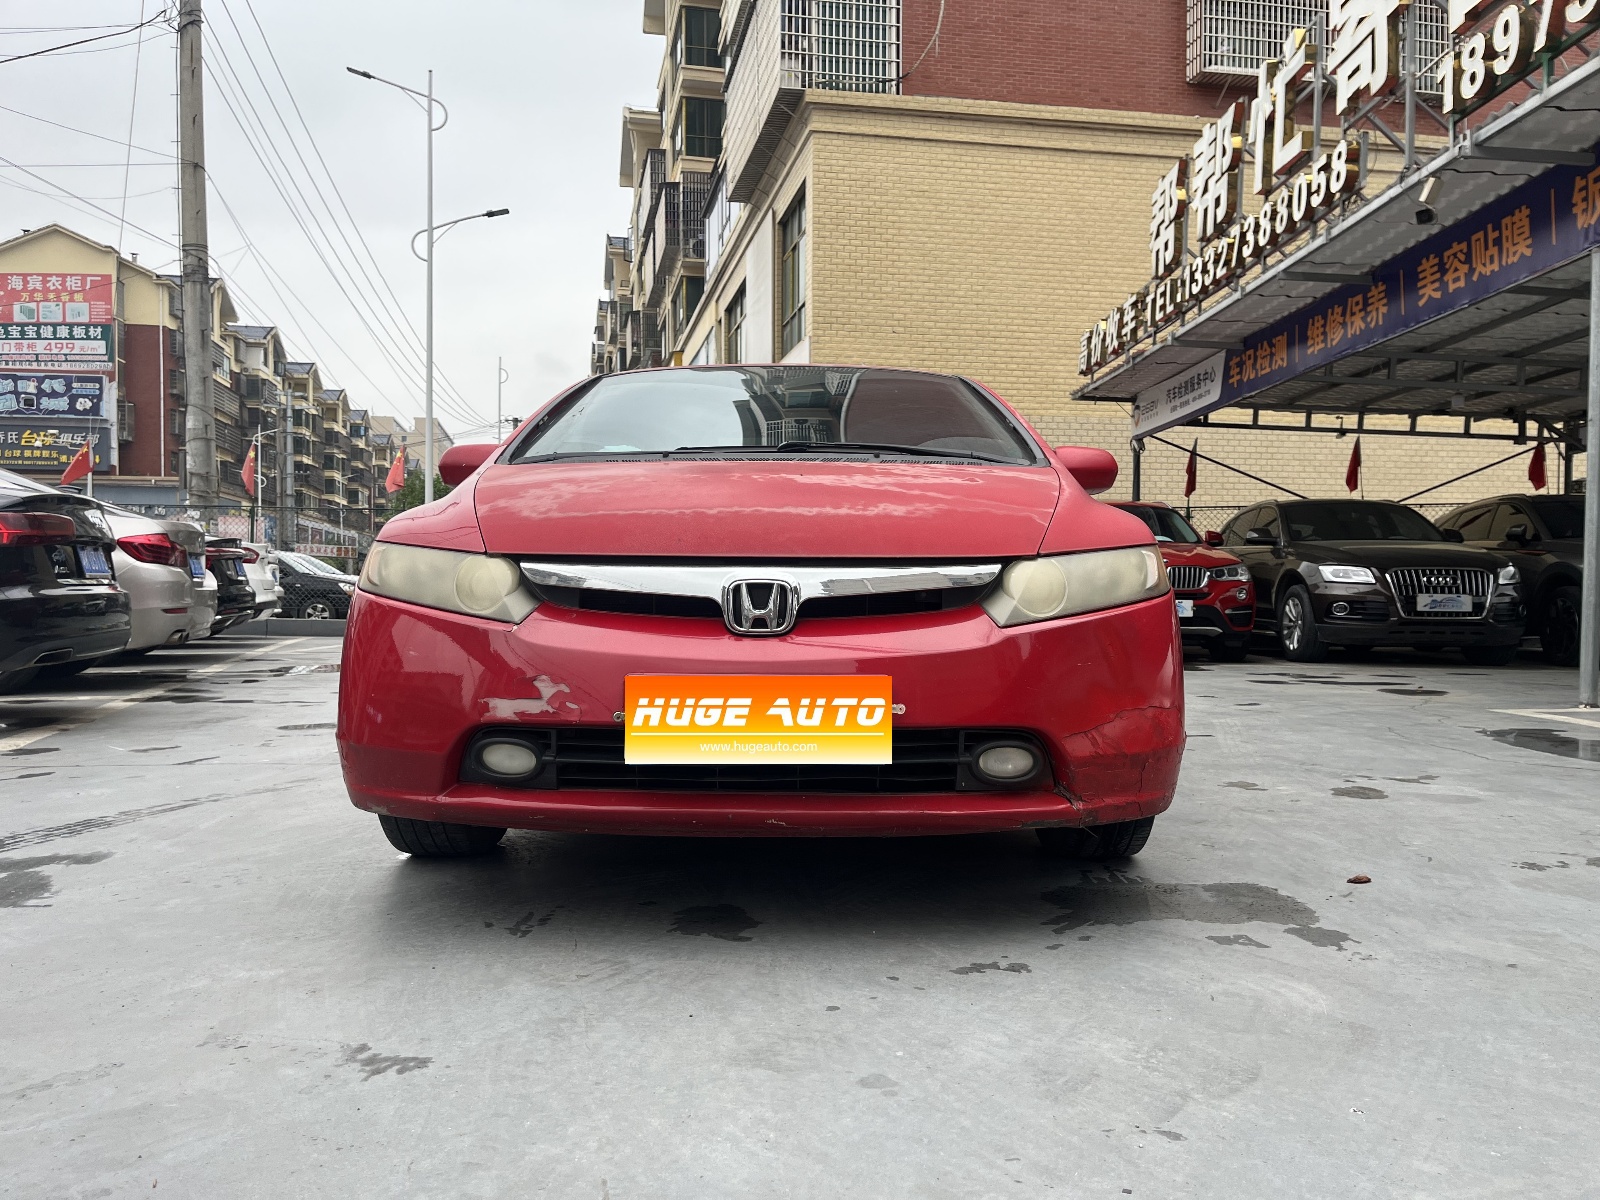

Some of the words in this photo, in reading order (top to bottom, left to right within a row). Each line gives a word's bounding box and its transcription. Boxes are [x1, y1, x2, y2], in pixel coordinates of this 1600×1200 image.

[7, 275, 102, 291] 海宾衣柜厂
[1228, 331, 1288, 388] 车况检测
[1306, 281, 1389, 355] 维修保养
[1417, 205, 1533, 307] 美容贴膜
[43, 342, 76, 353] 499
[1079, 293, 1137, 374] 高价收车
[1166, 366, 1217, 405] 汽车检测服务中心
